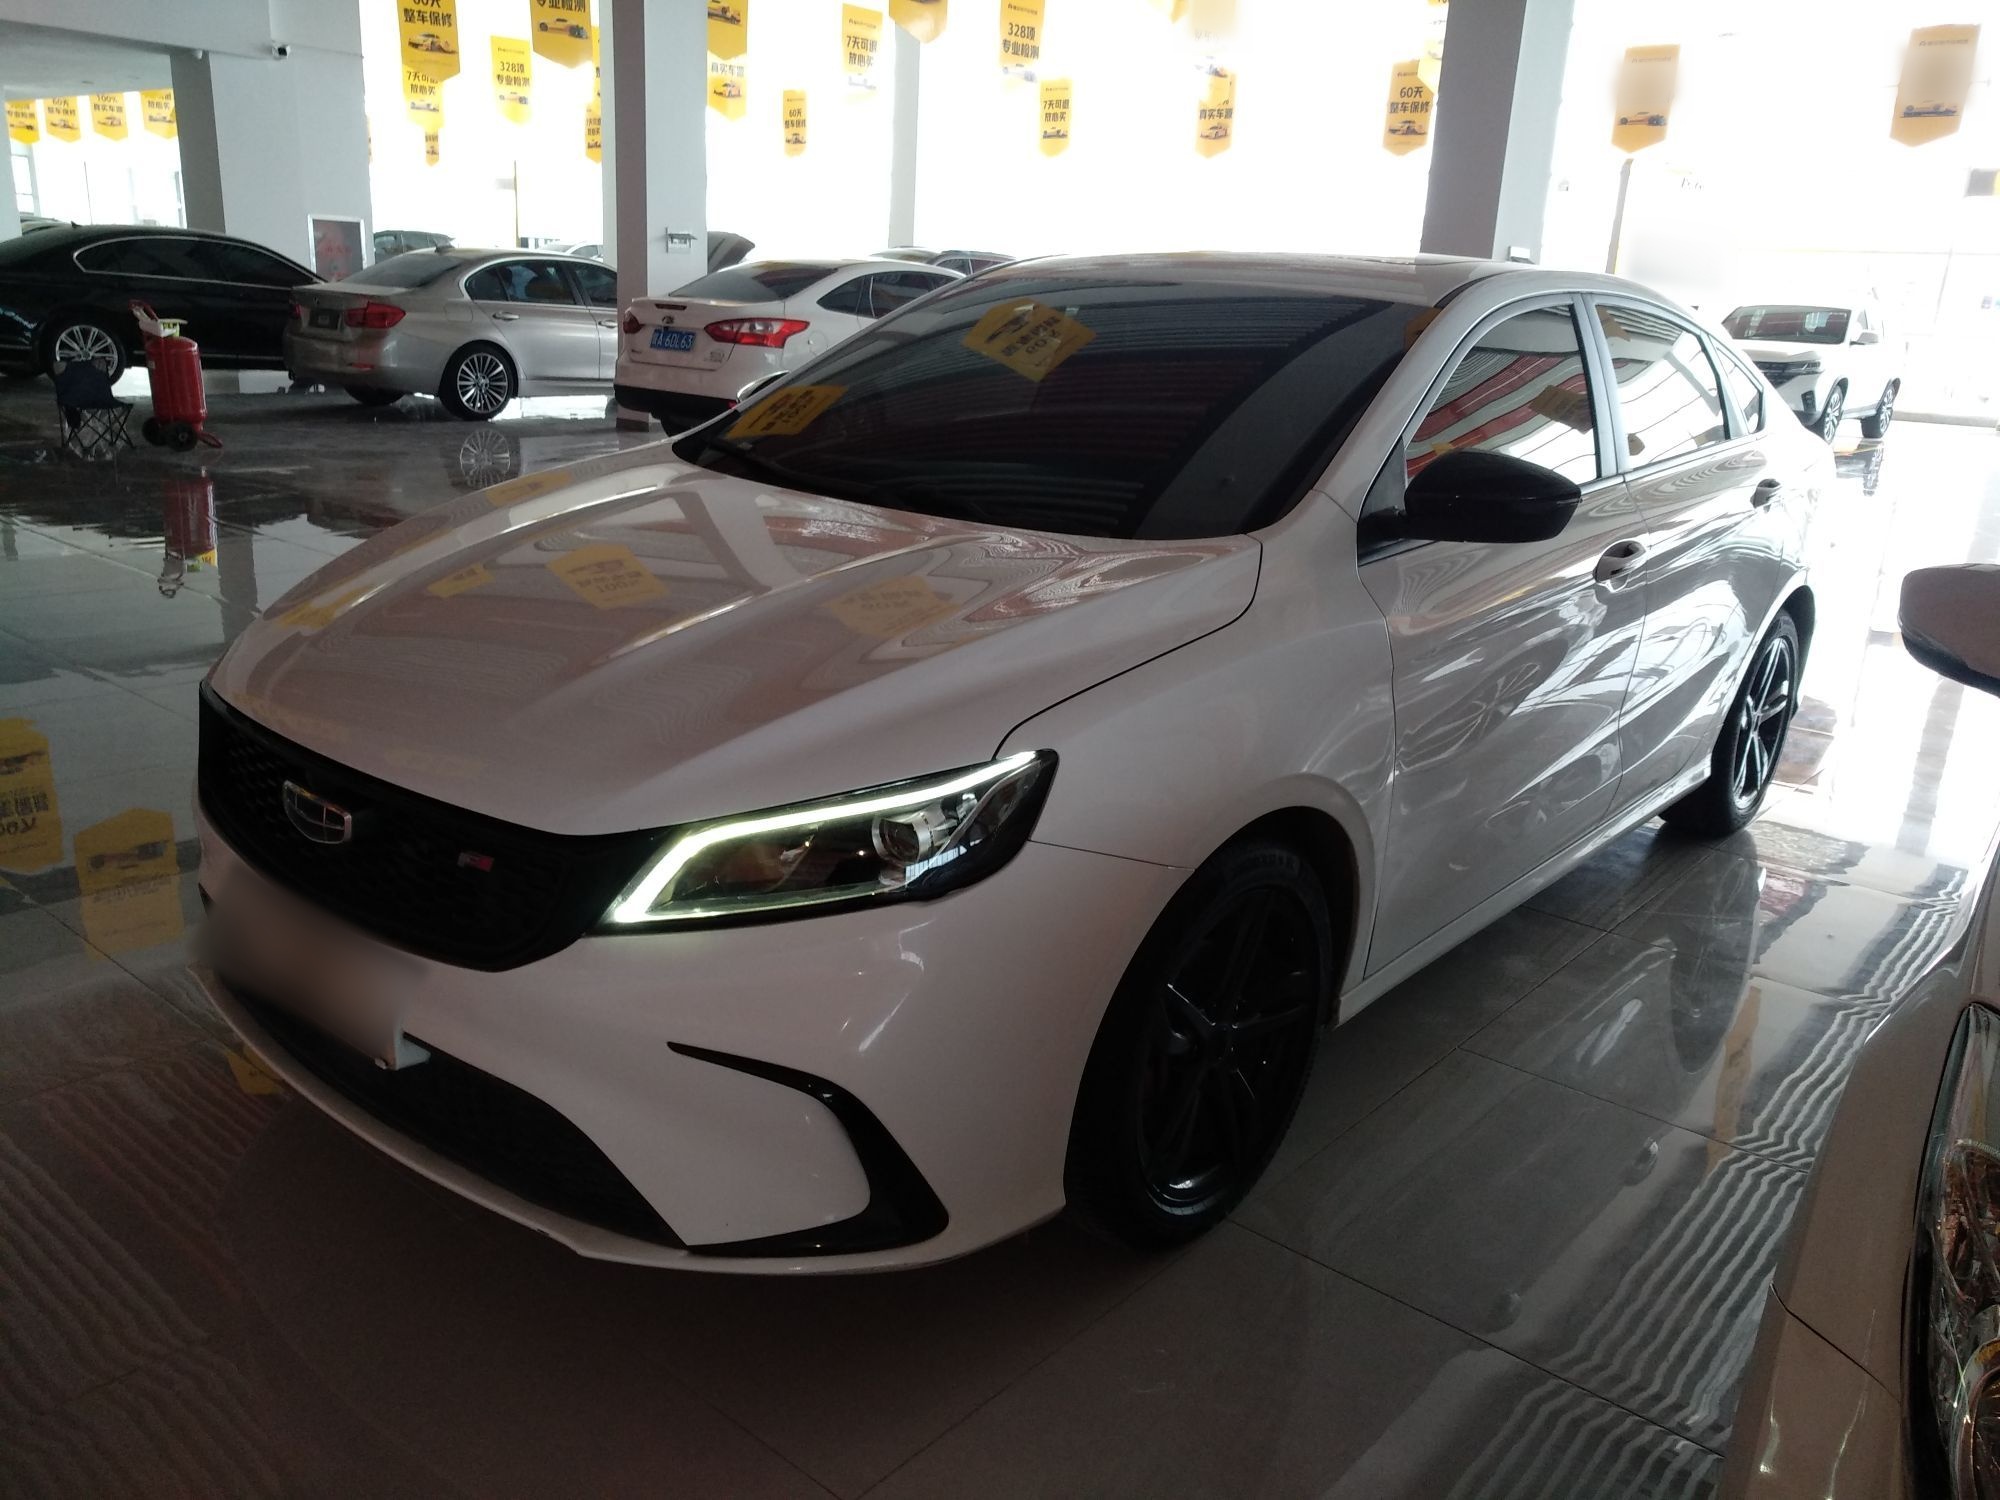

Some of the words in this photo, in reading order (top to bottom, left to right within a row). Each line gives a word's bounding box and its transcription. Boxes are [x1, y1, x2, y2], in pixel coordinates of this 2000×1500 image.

[403, 8, 452, 28] 整车保修
[1007, 22, 1036, 41] 328项
[1002, 39, 1040, 60] 专业检测
[1399, 86, 1424, 99] 60天
[1043, 99, 1070, 110] 7天可退
[1389, 101, 1431, 115] 整车保修
